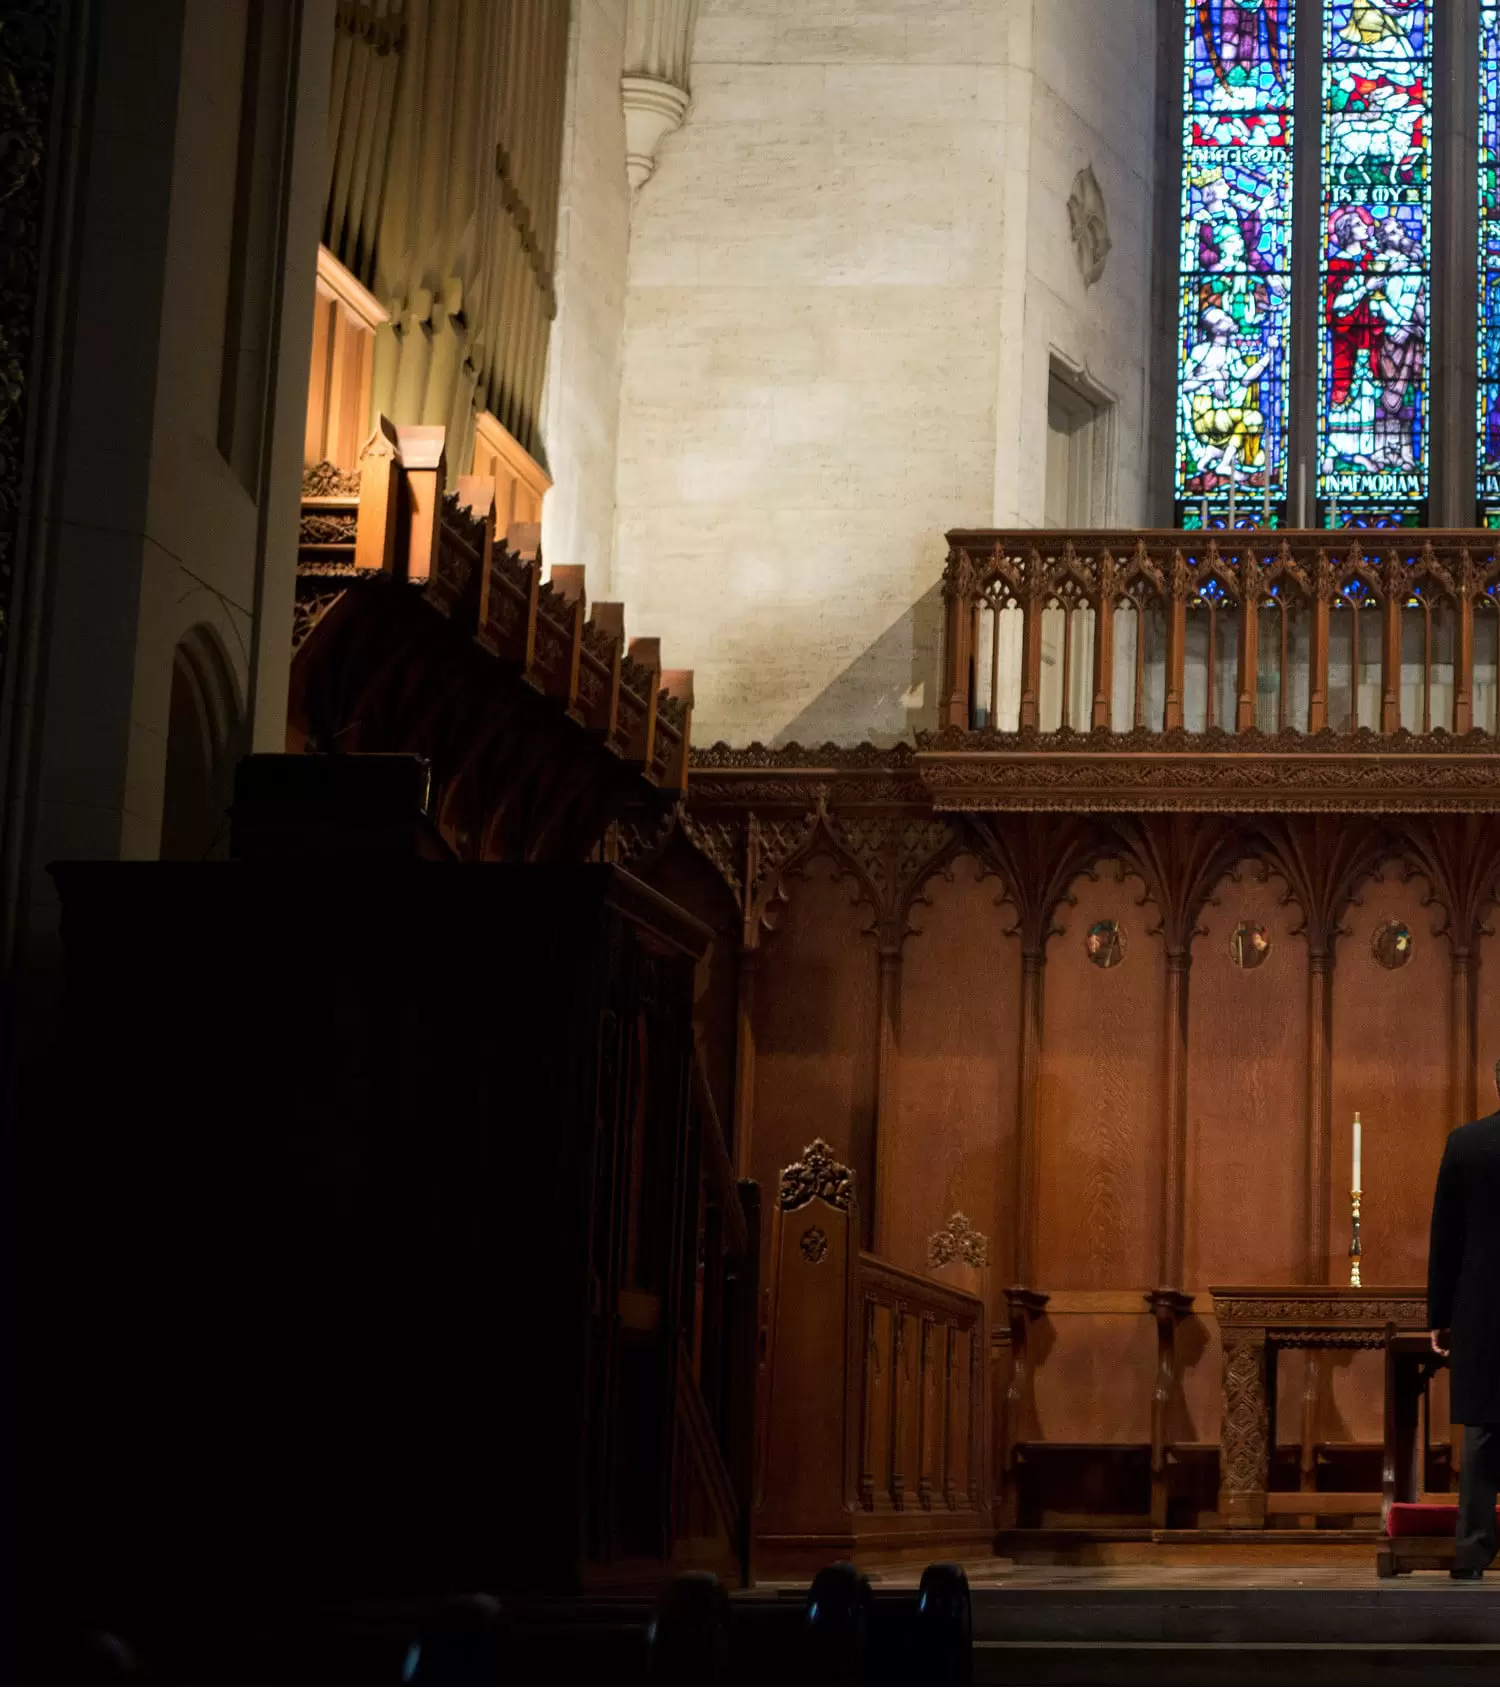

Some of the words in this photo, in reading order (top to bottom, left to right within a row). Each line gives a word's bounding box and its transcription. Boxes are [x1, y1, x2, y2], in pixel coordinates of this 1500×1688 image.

[1333, 188, 1351, 202] IS
[1371, 187, 1402, 202] MY
[1340, 475, 1420, 492] MEMORIAM
